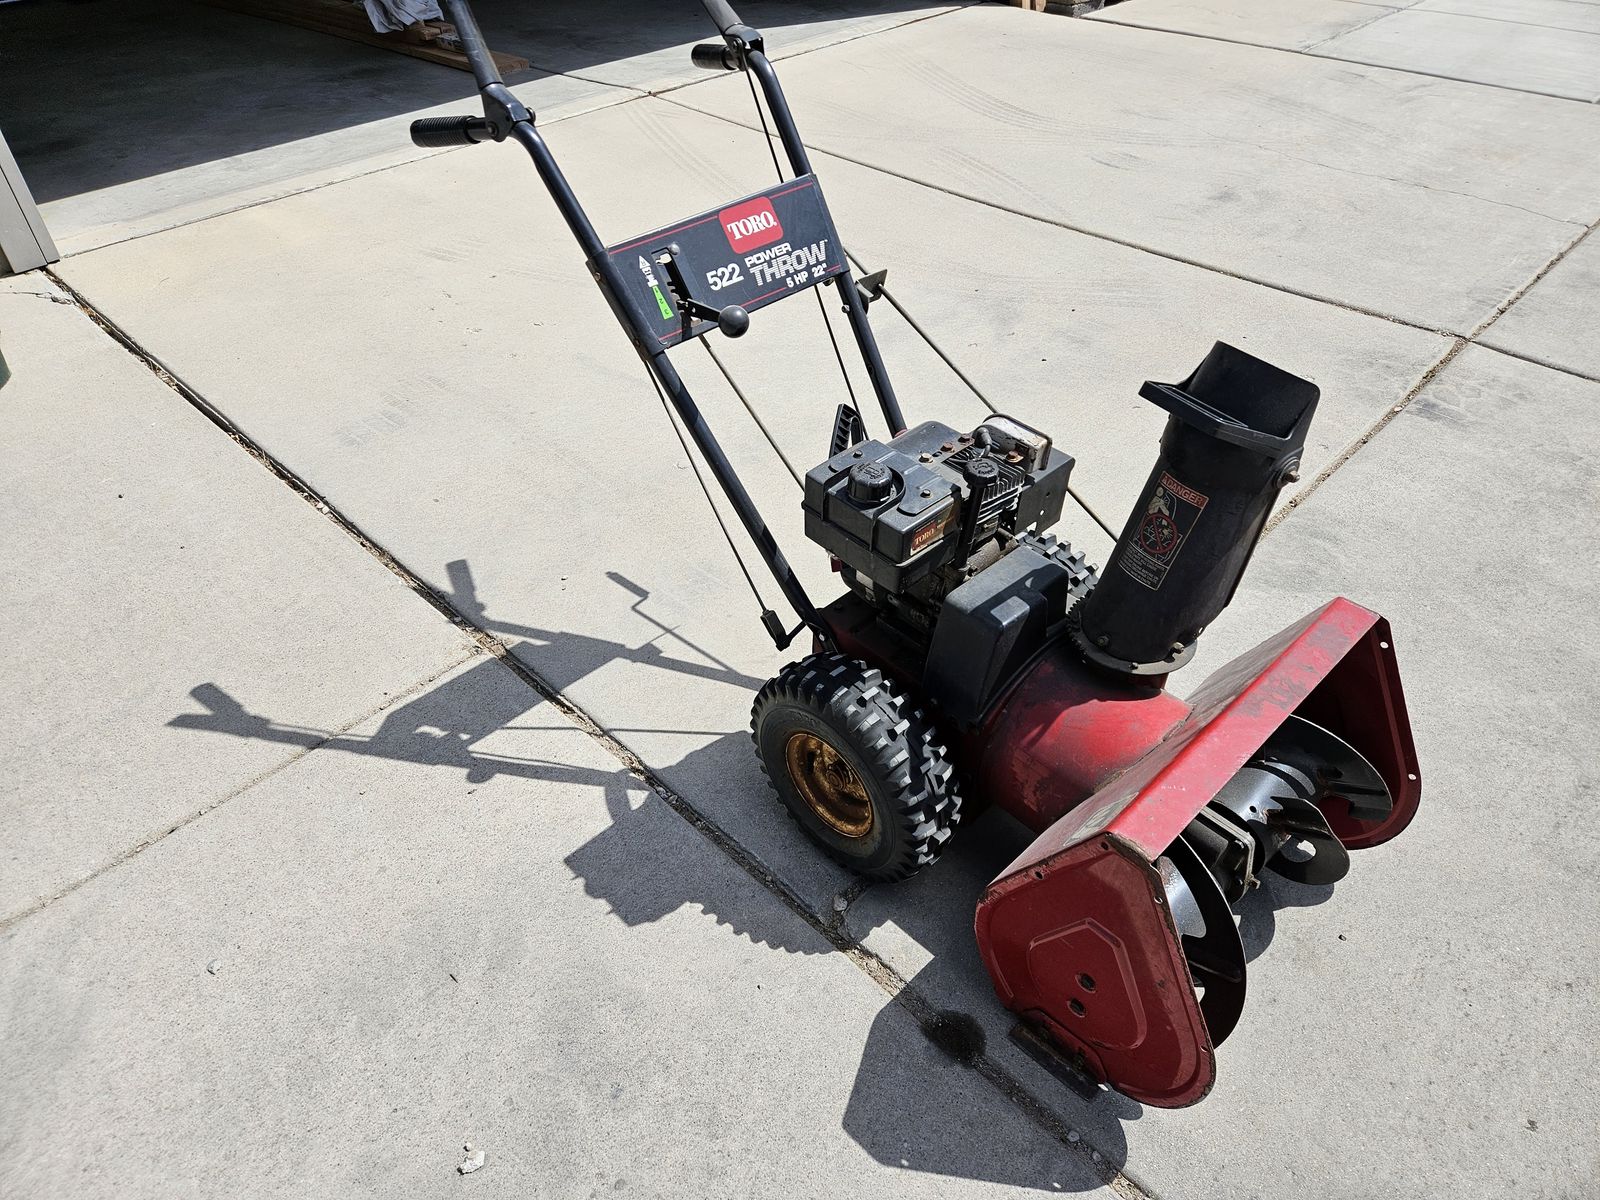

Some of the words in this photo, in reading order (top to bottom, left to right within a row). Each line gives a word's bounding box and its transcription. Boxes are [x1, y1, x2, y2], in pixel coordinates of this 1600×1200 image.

[727, 211, 775, 240] TORO
[705, 263, 744, 291] 522
[749, 240, 827, 286] THROW
[744, 242, 792, 268] POWER
[794, 271, 809, 285] HP
[1166, 481, 1205, 505] DANGER
[914, 528, 935, 545] TORO
